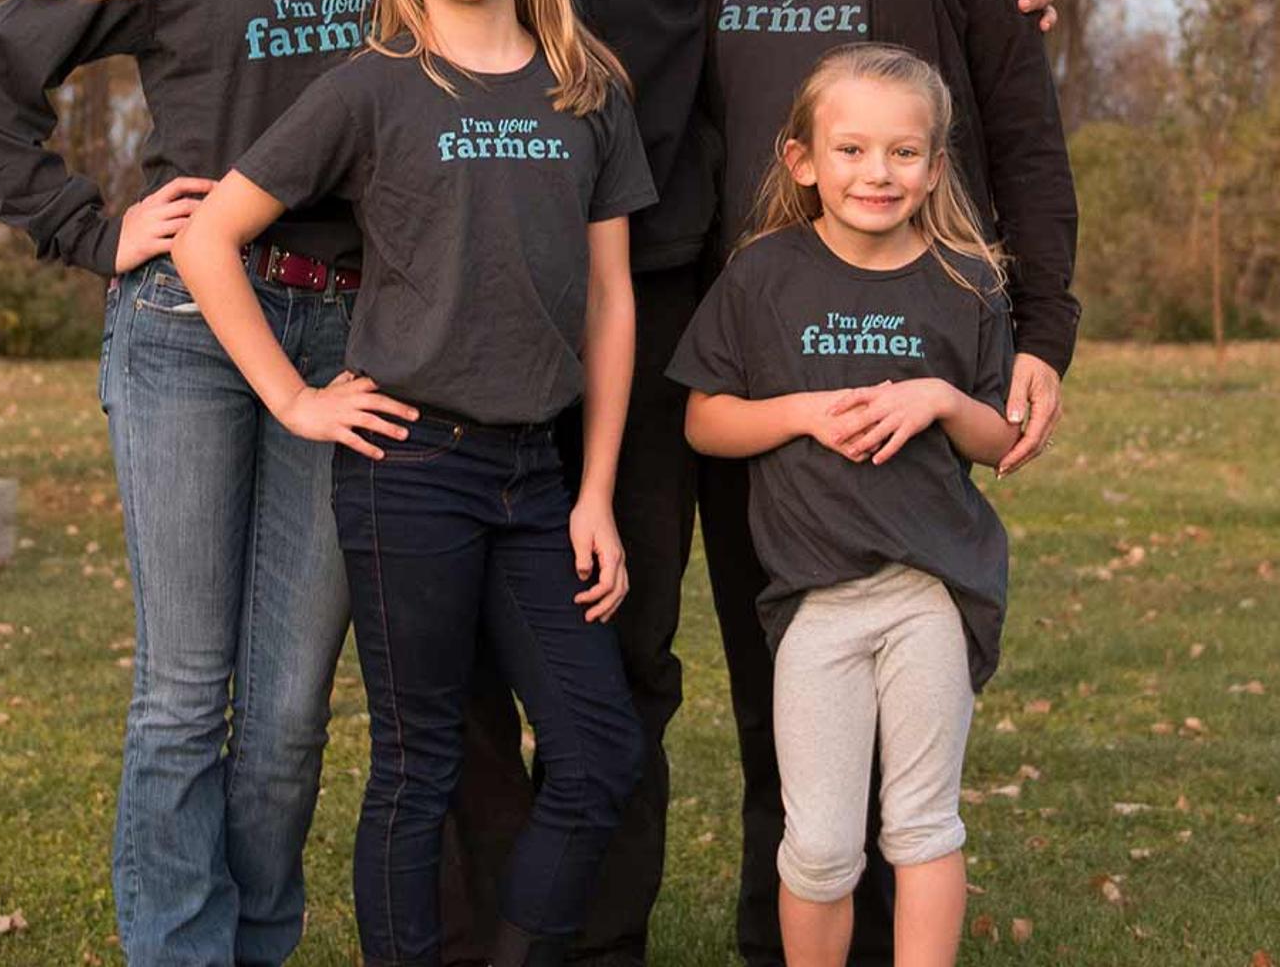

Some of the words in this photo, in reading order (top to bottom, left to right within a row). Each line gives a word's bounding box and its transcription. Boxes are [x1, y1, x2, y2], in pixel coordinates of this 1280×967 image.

[461, 117, 494, 133] I'm
[498, 118, 538, 138] your
[438, 132, 570, 160] farmer.
[827, 313, 858, 329] I'm
[861, 314, 904, 334] your
